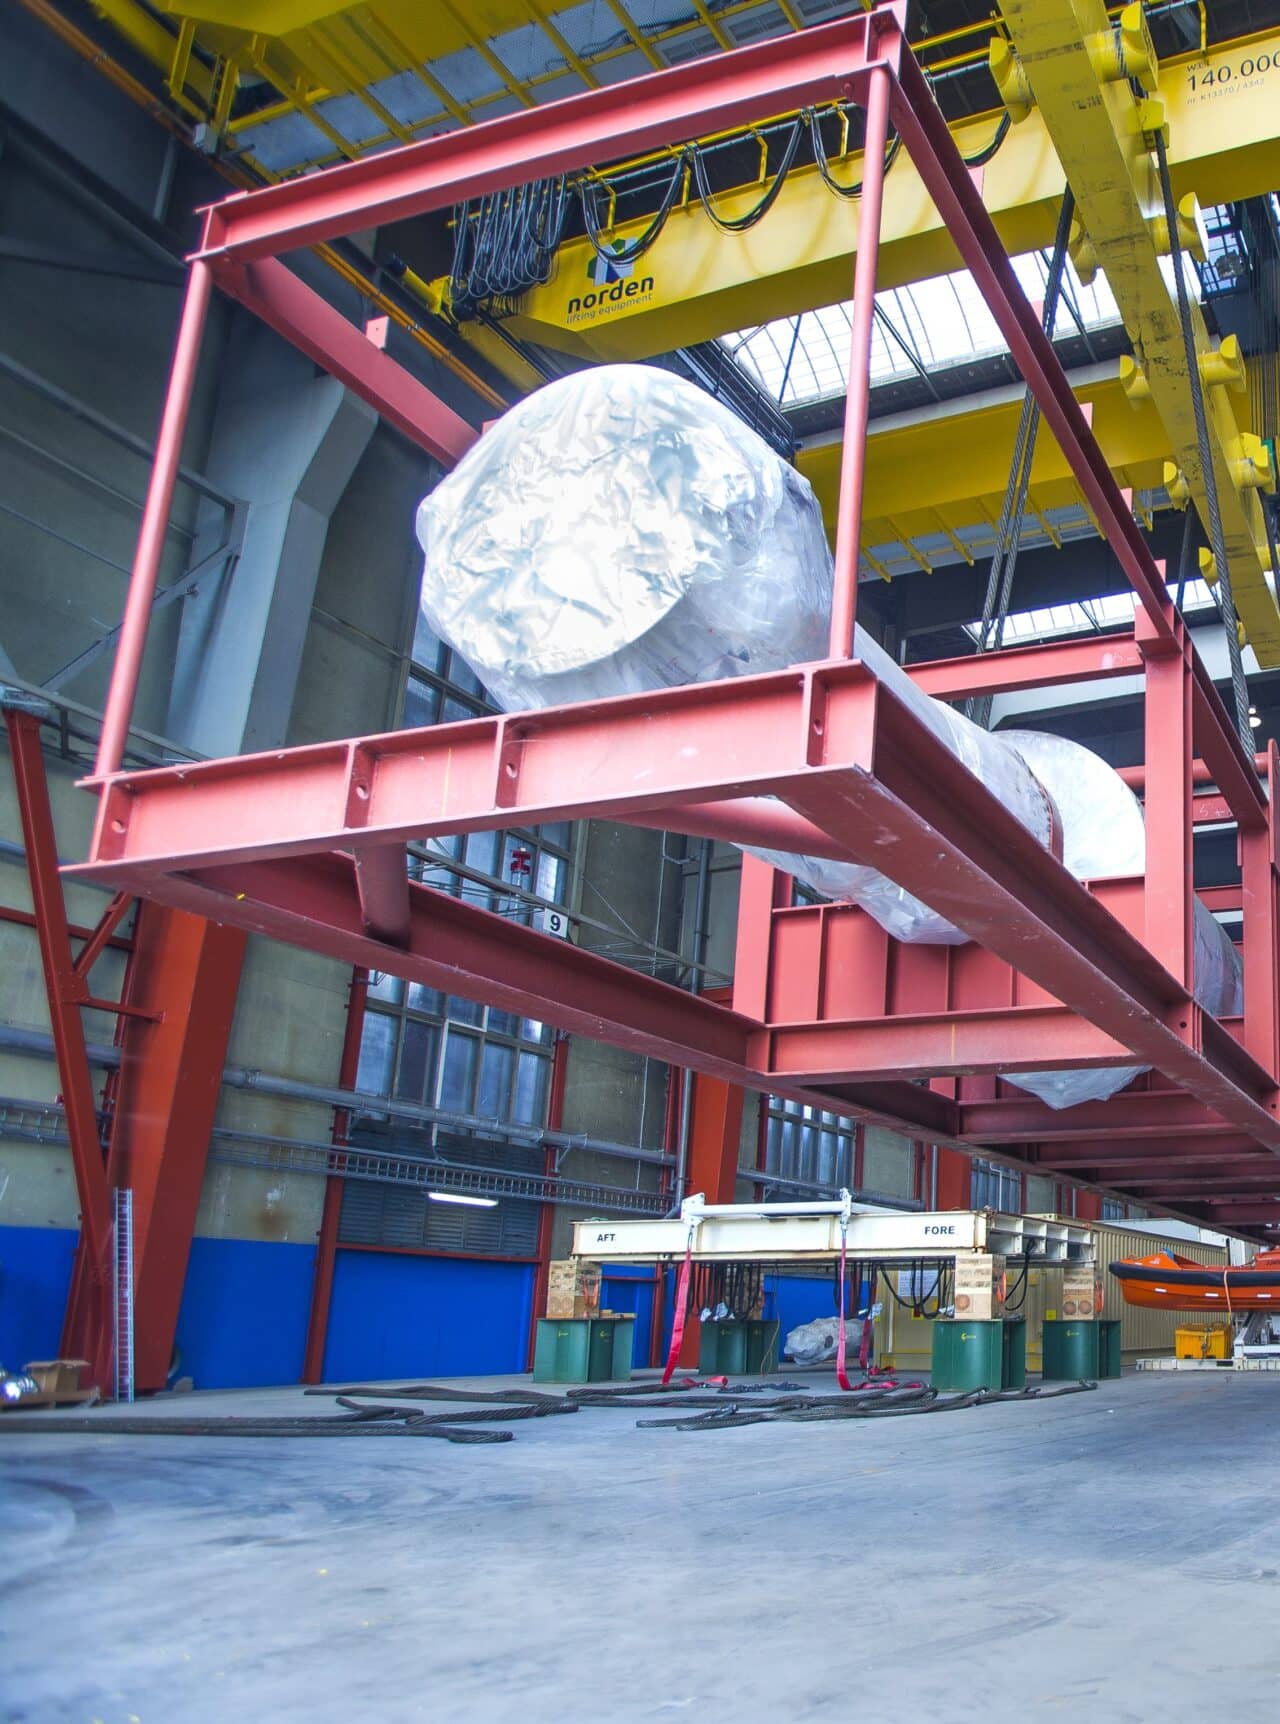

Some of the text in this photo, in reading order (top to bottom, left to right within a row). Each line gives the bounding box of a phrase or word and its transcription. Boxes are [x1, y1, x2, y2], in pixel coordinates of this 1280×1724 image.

[567, 276, 654, 314] norden
[566, 293, 653, 325] lifting equipment
[550, 914, 561, 932] 9
[596, 1233, 616, 1242] AFT
[924, 1225, 955, 1235] FORE
